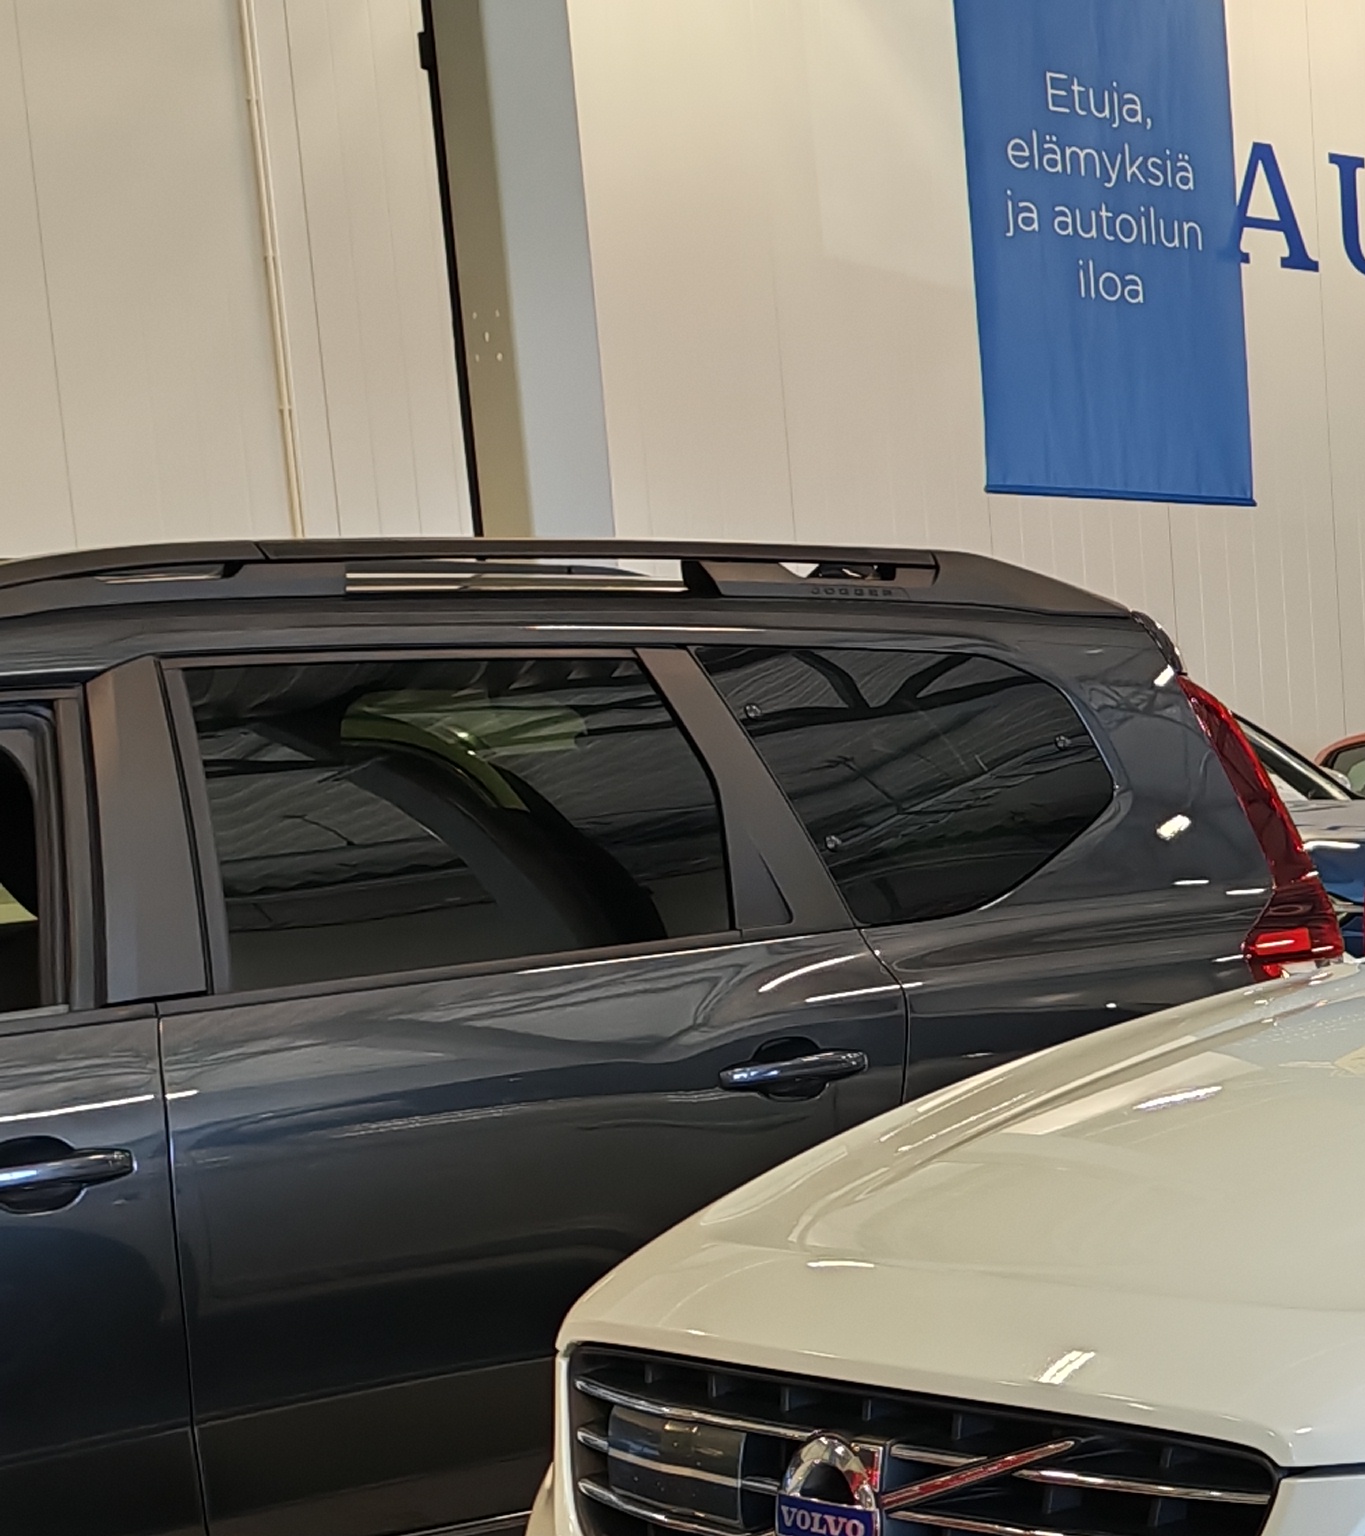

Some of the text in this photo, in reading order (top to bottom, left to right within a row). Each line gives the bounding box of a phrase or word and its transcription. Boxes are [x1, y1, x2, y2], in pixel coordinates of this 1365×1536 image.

[1045, 70, 1152, 130] Etuja,
[1006, 128, 1195, 191] elämyksiä
[1005, 189, 1203, 251] ja autoilun
[1077, 258, 1144, 304] iloa
